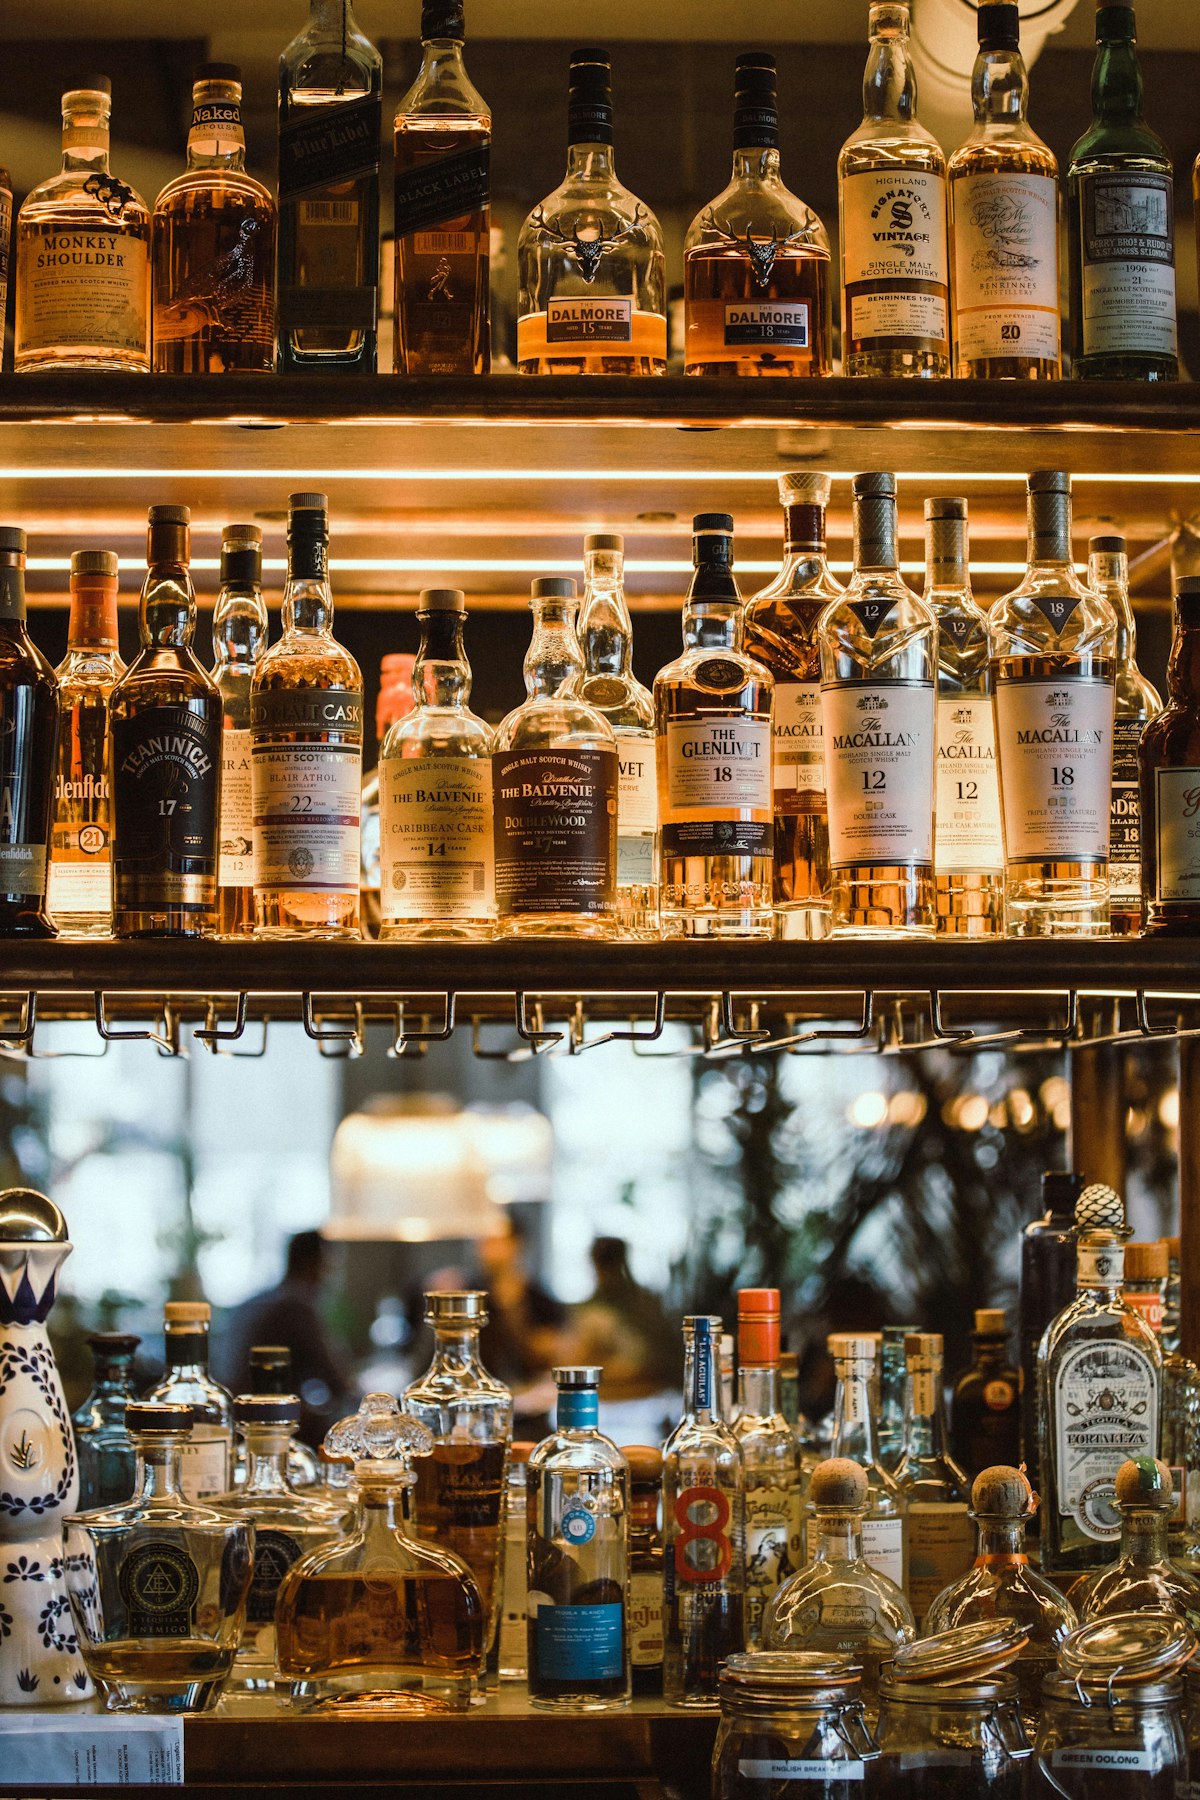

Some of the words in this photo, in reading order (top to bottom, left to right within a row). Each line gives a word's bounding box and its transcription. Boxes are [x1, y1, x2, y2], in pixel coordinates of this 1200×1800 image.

[193, 106, 240, 124] Naked
[399, 182, 441, 204] BLACK
[444, 167, 487, 188] LABEL
[876, 178, 927, 187] HIGHLAND
[871, 189, 931, 219] SIGNATORY
[44, 236, 117, 251] MONKEY
[873, 232, 930, 243] VINTAGE
[1089, 239, 1115, 249] BERRY
[1138, 239, 1146, 247] &
[1146, 240, 1166, 249] RUDD
[37, 252, 124, 268] SHOULDER
[869, 260, 906, 269] SINGLE
[909, 261, 932, 270] MALT
[860, 268, 901, 277] SCOTCH
[905, 269, 938, 277] WHISKY
[1126, 264, 1148, 273] 1996
[34, 280, 59, 288] BLENDED
[1132, 276, 1141, 284] 21
[552, 309, 625, 322] DALMORE
[730, 312, 803, 325] DALMORE
[582, 322, 596, 334] 15
[761, 326, 774, 337] 18
[1001, 325, 1020, 340] 20
[864, 605, 880, 617] 12
[1050, 602, 1065, 614] 18
[951, 622, 967, 633] 12
[322, 704, 360, 722] CASK
[797, 711, 817, 723] The
[859, 717, 882, 732] The
[1048, 713, 1071, 728] The
[711, 729, 736, 740] THE
[832, 732, 917, 750] MACALLAN
[953, 730, 974, 744] The
[1016, 729, 1103, 745] MACALLAN
[121, 735, 213, 779] TEANINICH
[682, 742, 761, 758] GLENLIVET
[838, 751, 869, 760] HIGHLAND
[937, 745, 996, 760] ACALLA
[149, 755, 164, 765] MALT
[164, 754, 186, 764] SCOTCH
[268, 754, 291, 763] MALT
[293, 754, 333, 763] SCOTCH
[393, 767, 412, 782] SINGLE
[413, 763, 432, 772] MALT
[433, 763, 460, 772] SCOTCH
[461, 767, 484, 781] WHISKY
[501, 762, 519, 776] SINGLE
[520, 756, 538, 766] MALT
[538, 756, 566, 765] SCOTCH
[567, 759, 593, 774] WHISKY
[270, 773, 299, 782] BLAIR
[302, 773, 337, 782] ATHOL
[713, 766, 733, 782] 18
[861, 770, 887, 790] 12
[1050, 766, 1075, 786] 18
[393, 793, 413, 803] THE
[416, 789, 485, 803] BALVENIE
[501, 788, 520, 798] THE
[522, 784, 593, 797] BALVENIE
[955, 781, 978, 800] 12
[1122, 791, 1138, 800] The
[158, 799, 177, 816] 17
[291, 795, 313, 813] 22
[392, 823, 454, 833] CARIBBEAN
[456, 823, 485, 833] CASK
[1123, 828, 1139, 842] 18
[83, 831, 102, 847] 21
[427, 842, 448, 857] 14
[232, 861, 244, 871] 12
[698, 1361, 707, 1399] AGUILAS
[1067, 1433, 1146, 1446] FORTALEZA
[674, 1486, 732, 1585] 8
[140, 1616, 179, 1624] TEQUILA
[133, 1625, 187, 1633] ENEMIGO
[1061, 1753, 1093, 1764] GREEN
[1095, 1754, 1140, 1765] OOLONG
[772, 1765, 802, 1773] ENGLISH
[804, 1765, 842, 1773] BREAKT
